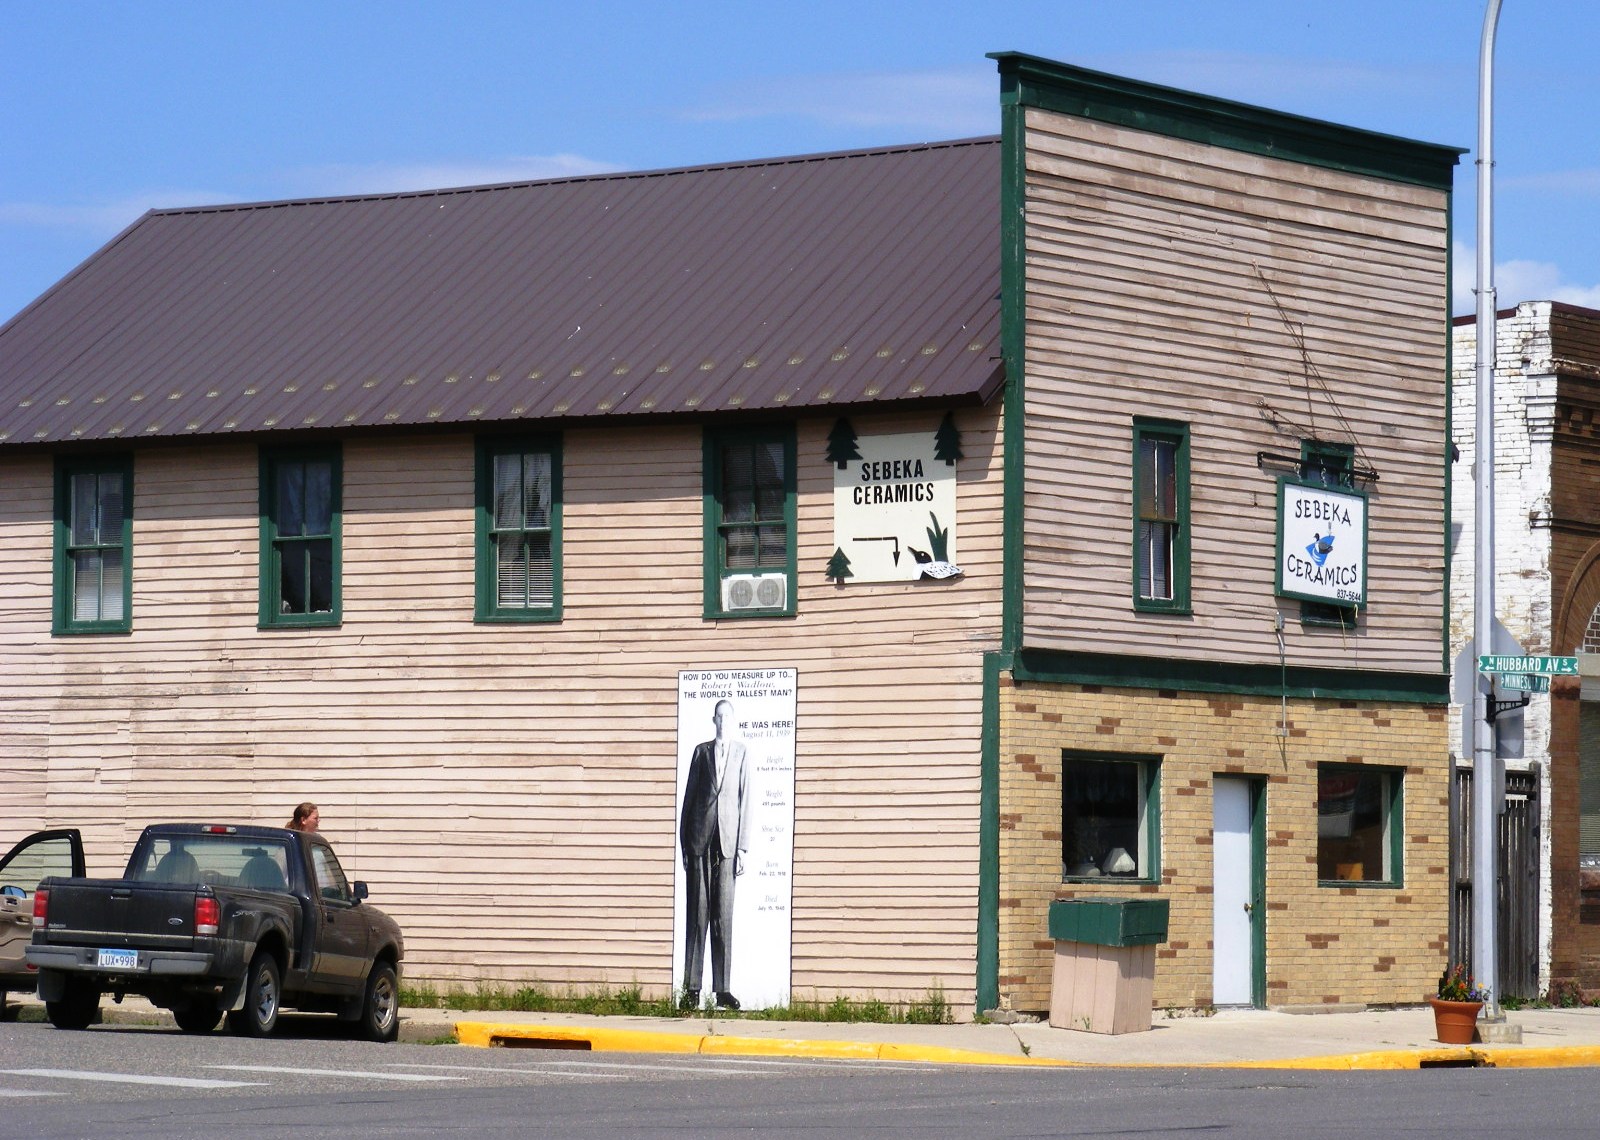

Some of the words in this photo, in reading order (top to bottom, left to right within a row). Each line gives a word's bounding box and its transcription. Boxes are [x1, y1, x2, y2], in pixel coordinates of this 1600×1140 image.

[861, 459, 924, 481] SEBEKA
[853, 482, 934, 505] CERAMICS
[1295, 499, 1352, 527] SEBEKA
[1287, 554, 1357, 587] CERAMICS
[1488, 657, 1495, 665] N
[1496, 657, 1541, 671] HUBBARD
[1545, 658, 1560, 672] AV.
[1562, 658, 1568, 666] S
[715, 672, 729, 680] YOU
[700, 681, 732, 690] Robert
[684, 691, 697, 699] THE
[700, 690, 733, 698] WORLD'S
[737, 689, 768, 698] TALLEST
[739, 721, 749, 729] HE
[752, 721, 769, 729] WAS
[771, 720, 794, 728] HERE!
